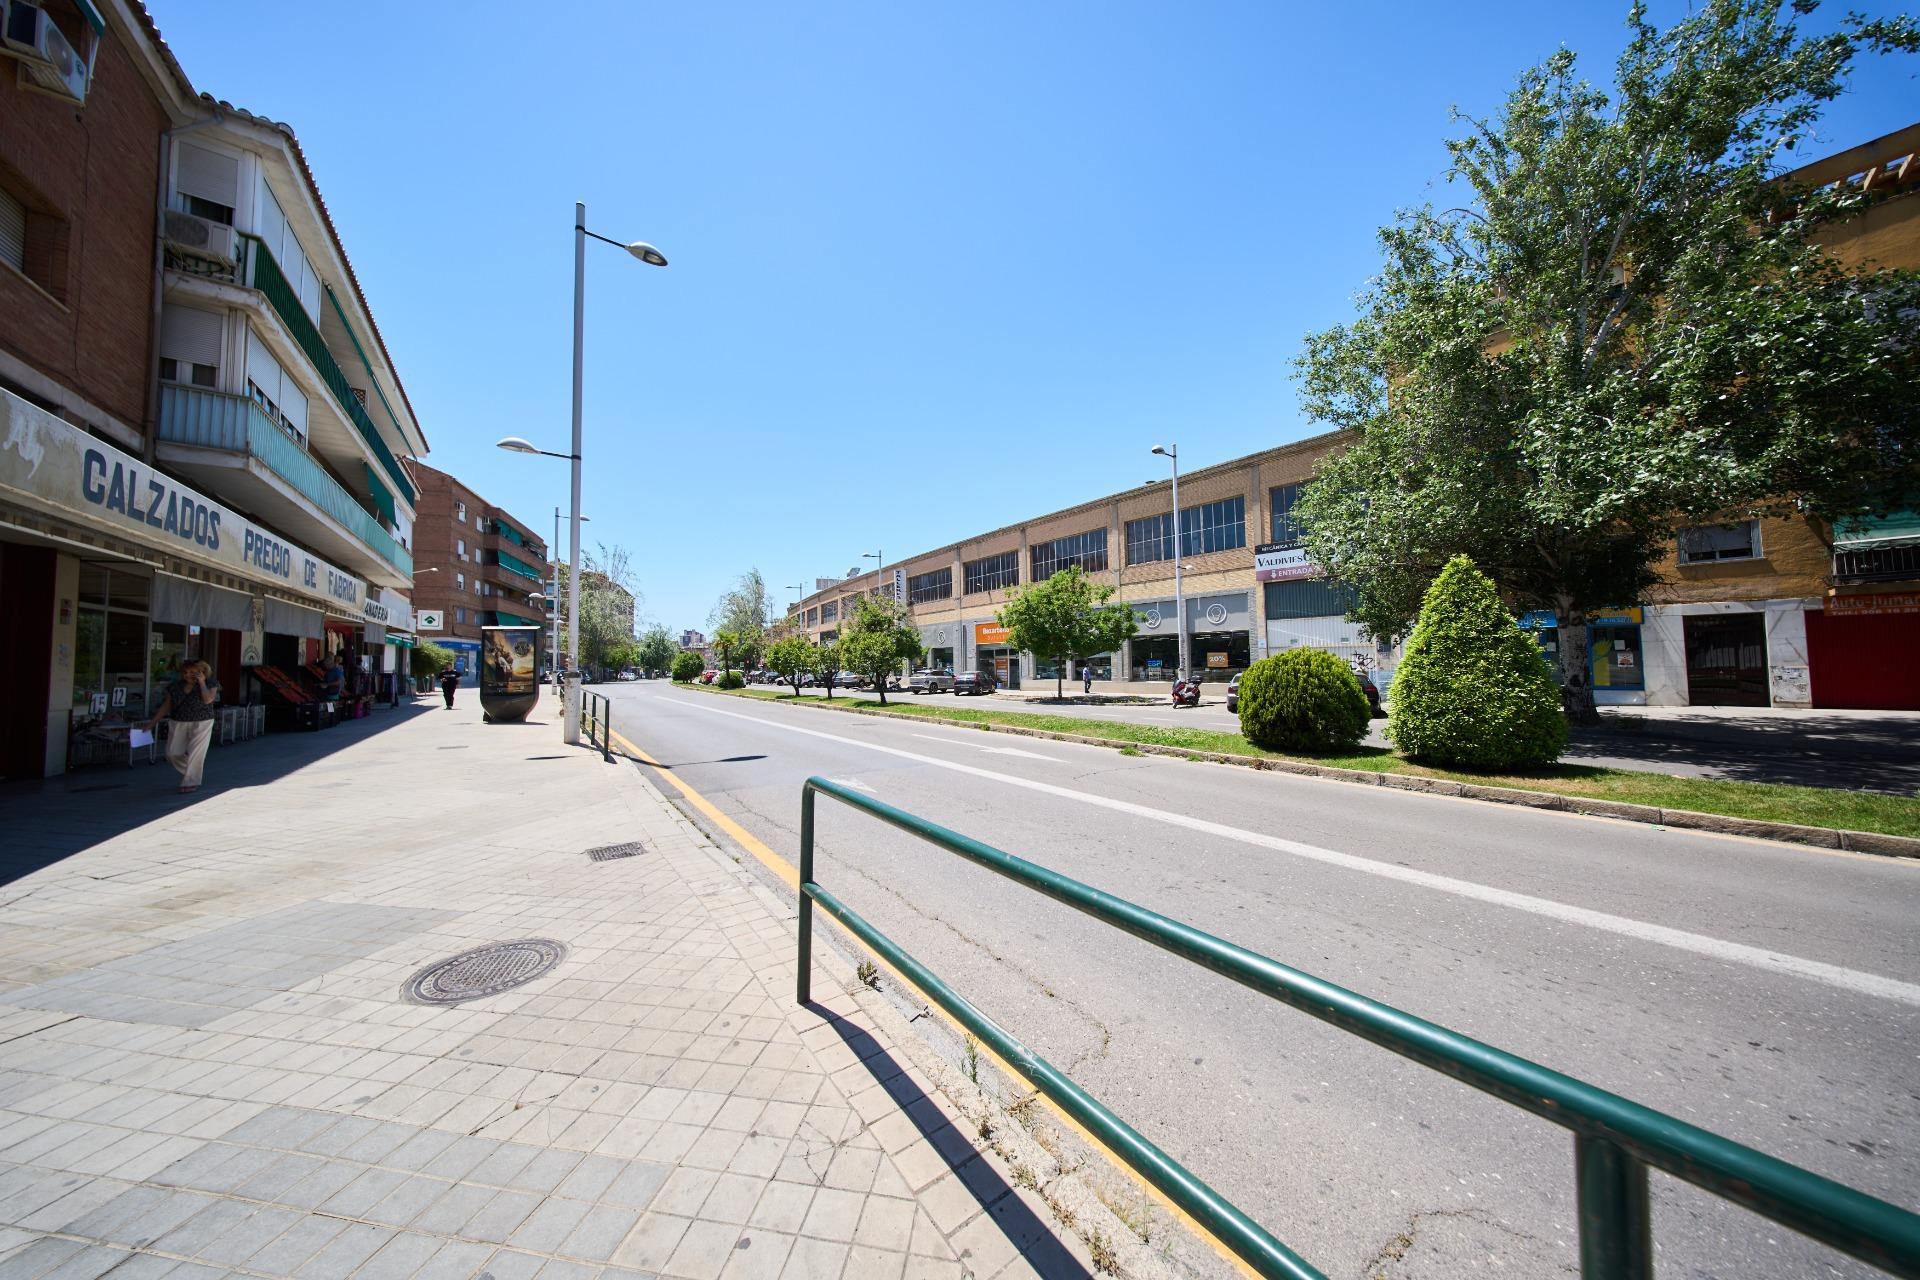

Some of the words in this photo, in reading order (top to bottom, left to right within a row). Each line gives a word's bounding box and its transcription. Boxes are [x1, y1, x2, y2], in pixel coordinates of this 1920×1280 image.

[83, 448, 221, 550] CALZADOS
[243, 527, 291, 578] PRECIO
[304, 558, 317, 589] DE
[328, 570, 357, 604] FABRICA
[1278, 567, 1314, 577] ENTRADA
[364, 601, 389, 622] ANADERIA
[113, 688, 125, 705] 12
